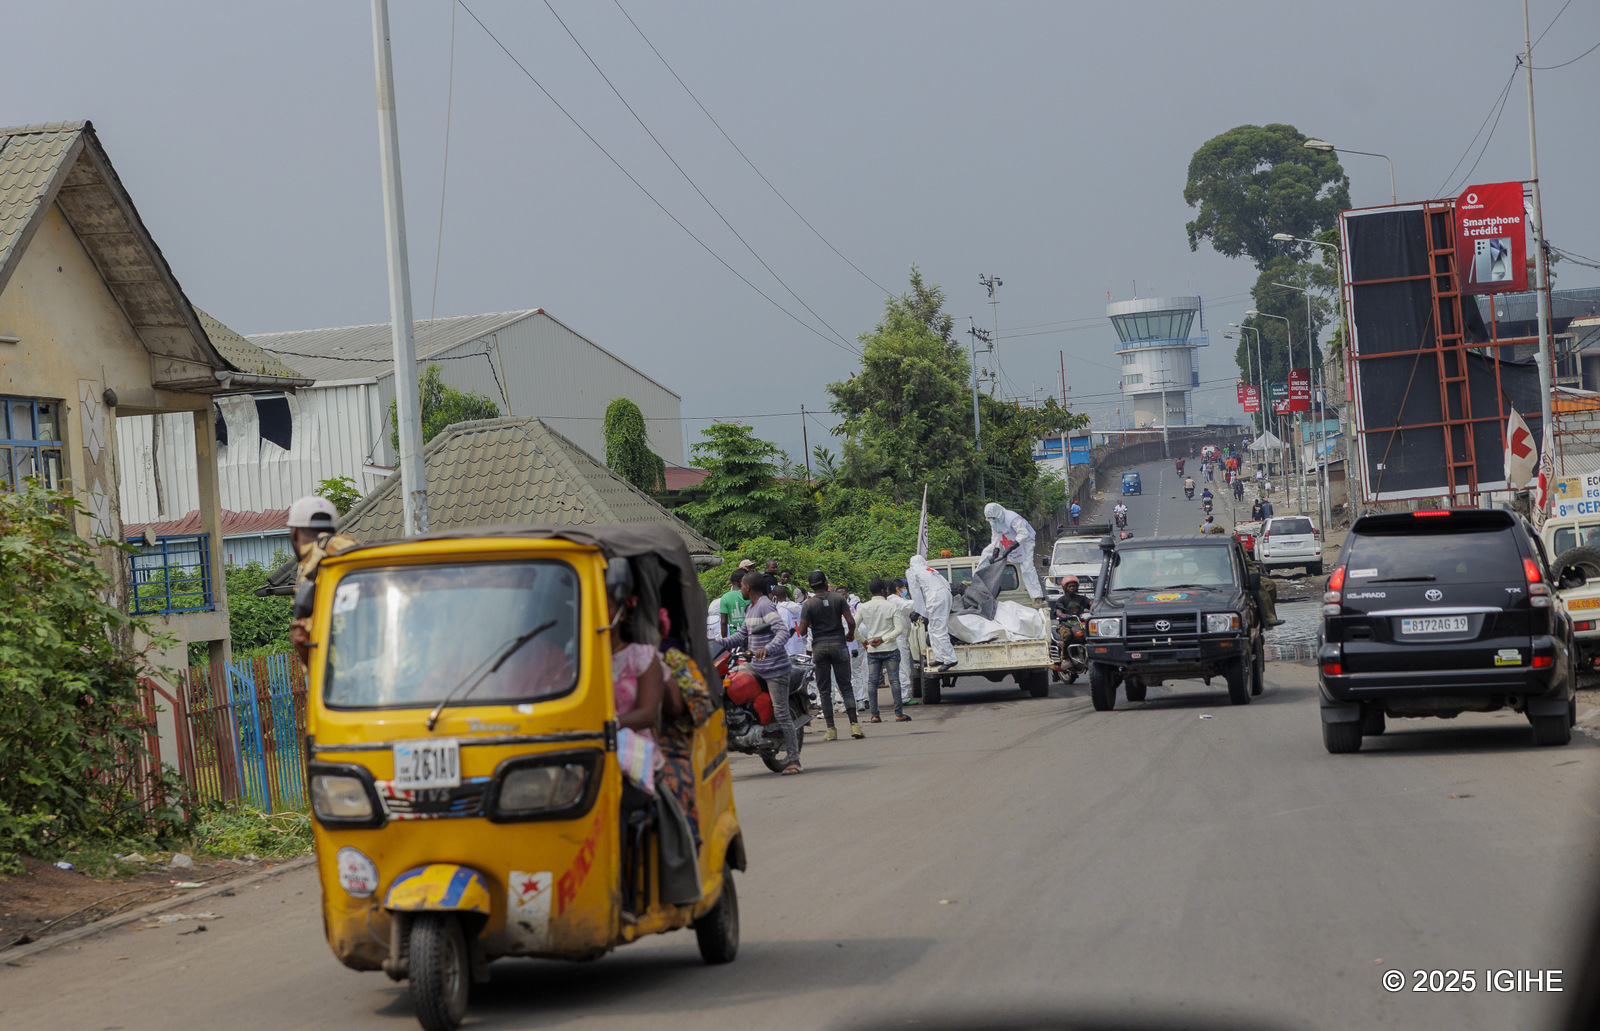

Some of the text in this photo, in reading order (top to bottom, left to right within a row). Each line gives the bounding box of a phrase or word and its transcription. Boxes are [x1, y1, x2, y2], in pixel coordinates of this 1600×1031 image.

[1463, 216, 1520, 226] Smartphone
[1463, 227, 1470, 236] à
[1470, 226, 1498, 236] crédit
[1587, 476, 1600, 486] EC
[1412, 618, 1466, 631] 8172AG 19
